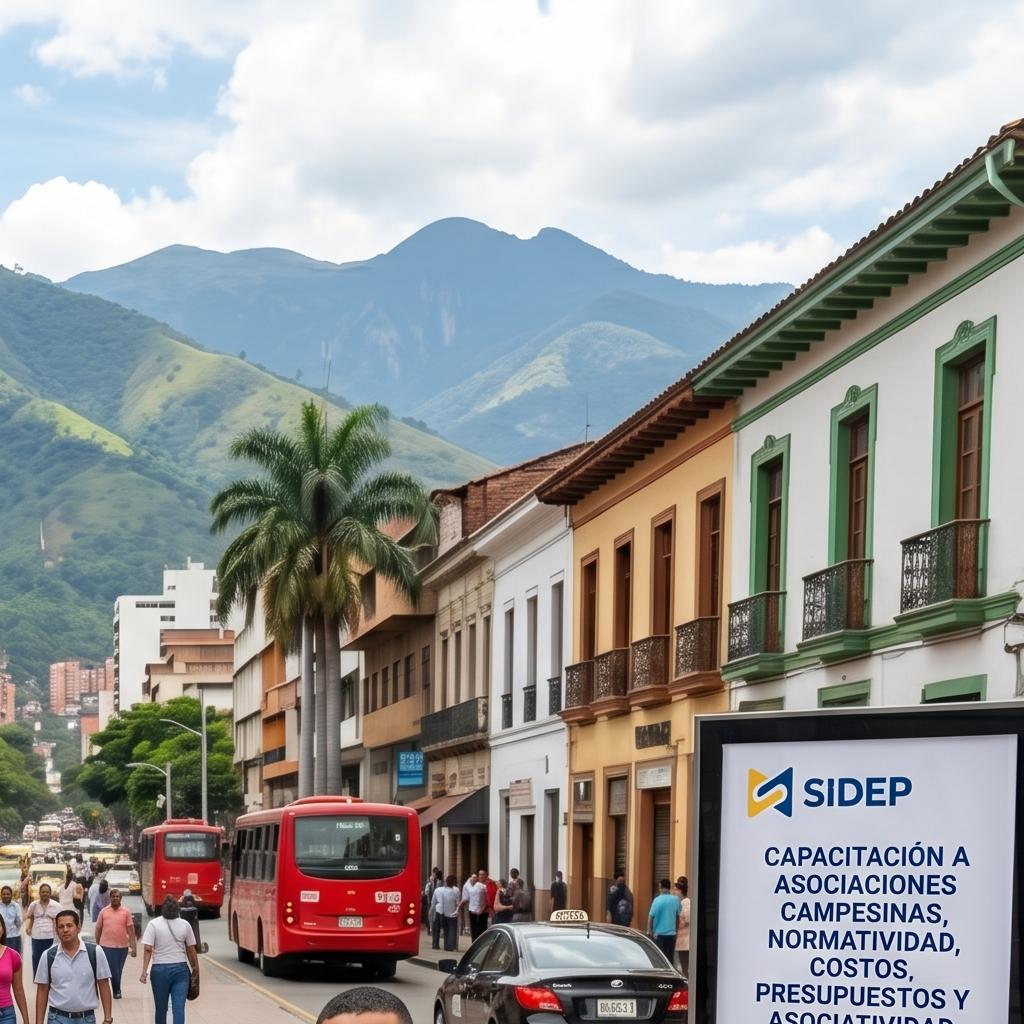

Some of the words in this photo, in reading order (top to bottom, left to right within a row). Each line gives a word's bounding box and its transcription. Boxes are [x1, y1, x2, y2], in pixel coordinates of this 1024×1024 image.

[804, 777, 912, 807] SIDEP
[765, 842, 943, 866] CAPACITACIÓN
[952, 847, 970, 866] A
[774, 874, 956, 895] ASOCIACIONES
[781, 902, 948, 927] CAMPESINAS,
[769, 930, 960, 956] NORMATIVIDAD,
[810, 957, 913, 982] COSTOS,
[757, 983, 945, 1009] PRESUPUESTOS
[954, 990, 970, 1010] Y
